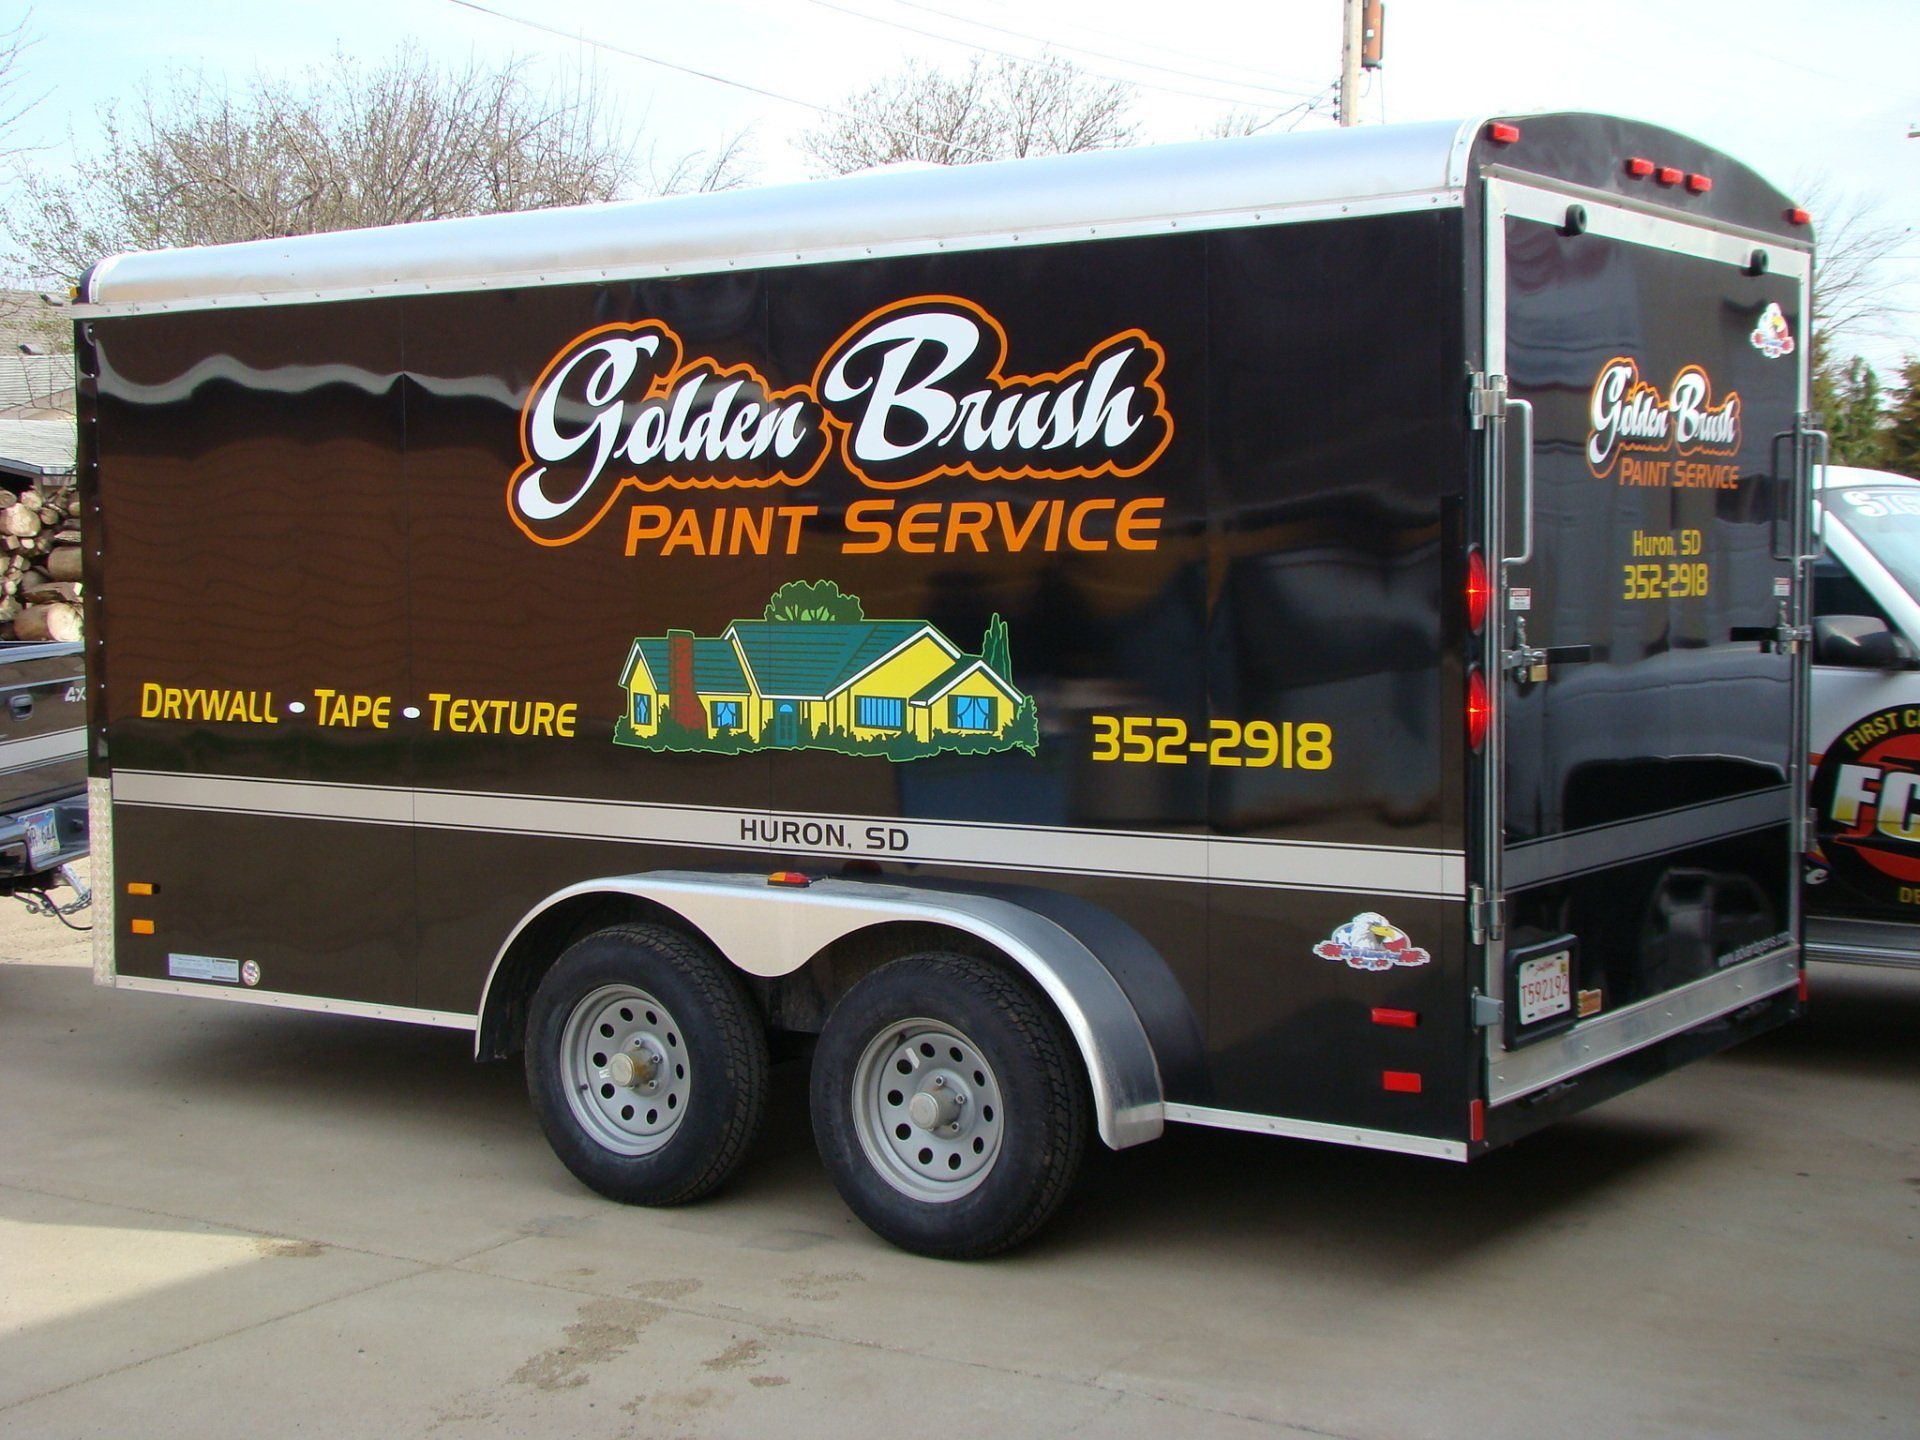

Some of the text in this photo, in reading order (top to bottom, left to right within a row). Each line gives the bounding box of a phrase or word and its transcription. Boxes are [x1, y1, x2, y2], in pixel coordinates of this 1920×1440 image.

[517, 312, 1144, 520] Golden Brush
[1590, 365, 1735, 464] Golden Brush
[1618, 456, 1740, 490] PAINT SERVICE
[624, 498, 1166, 557] PAINT SERVICE
[1680, 529, 1702, 556] SD
[1622, 562, 1709, 600] 352-2918
[140, 682, 578, 738] DRYWALL TAPE TEXTURE
[1844, 711, 1899, 752] FIRST
[1092, 715, 1333, 771] 352-2918
[740, 818, 910, 852] HURON, SD
